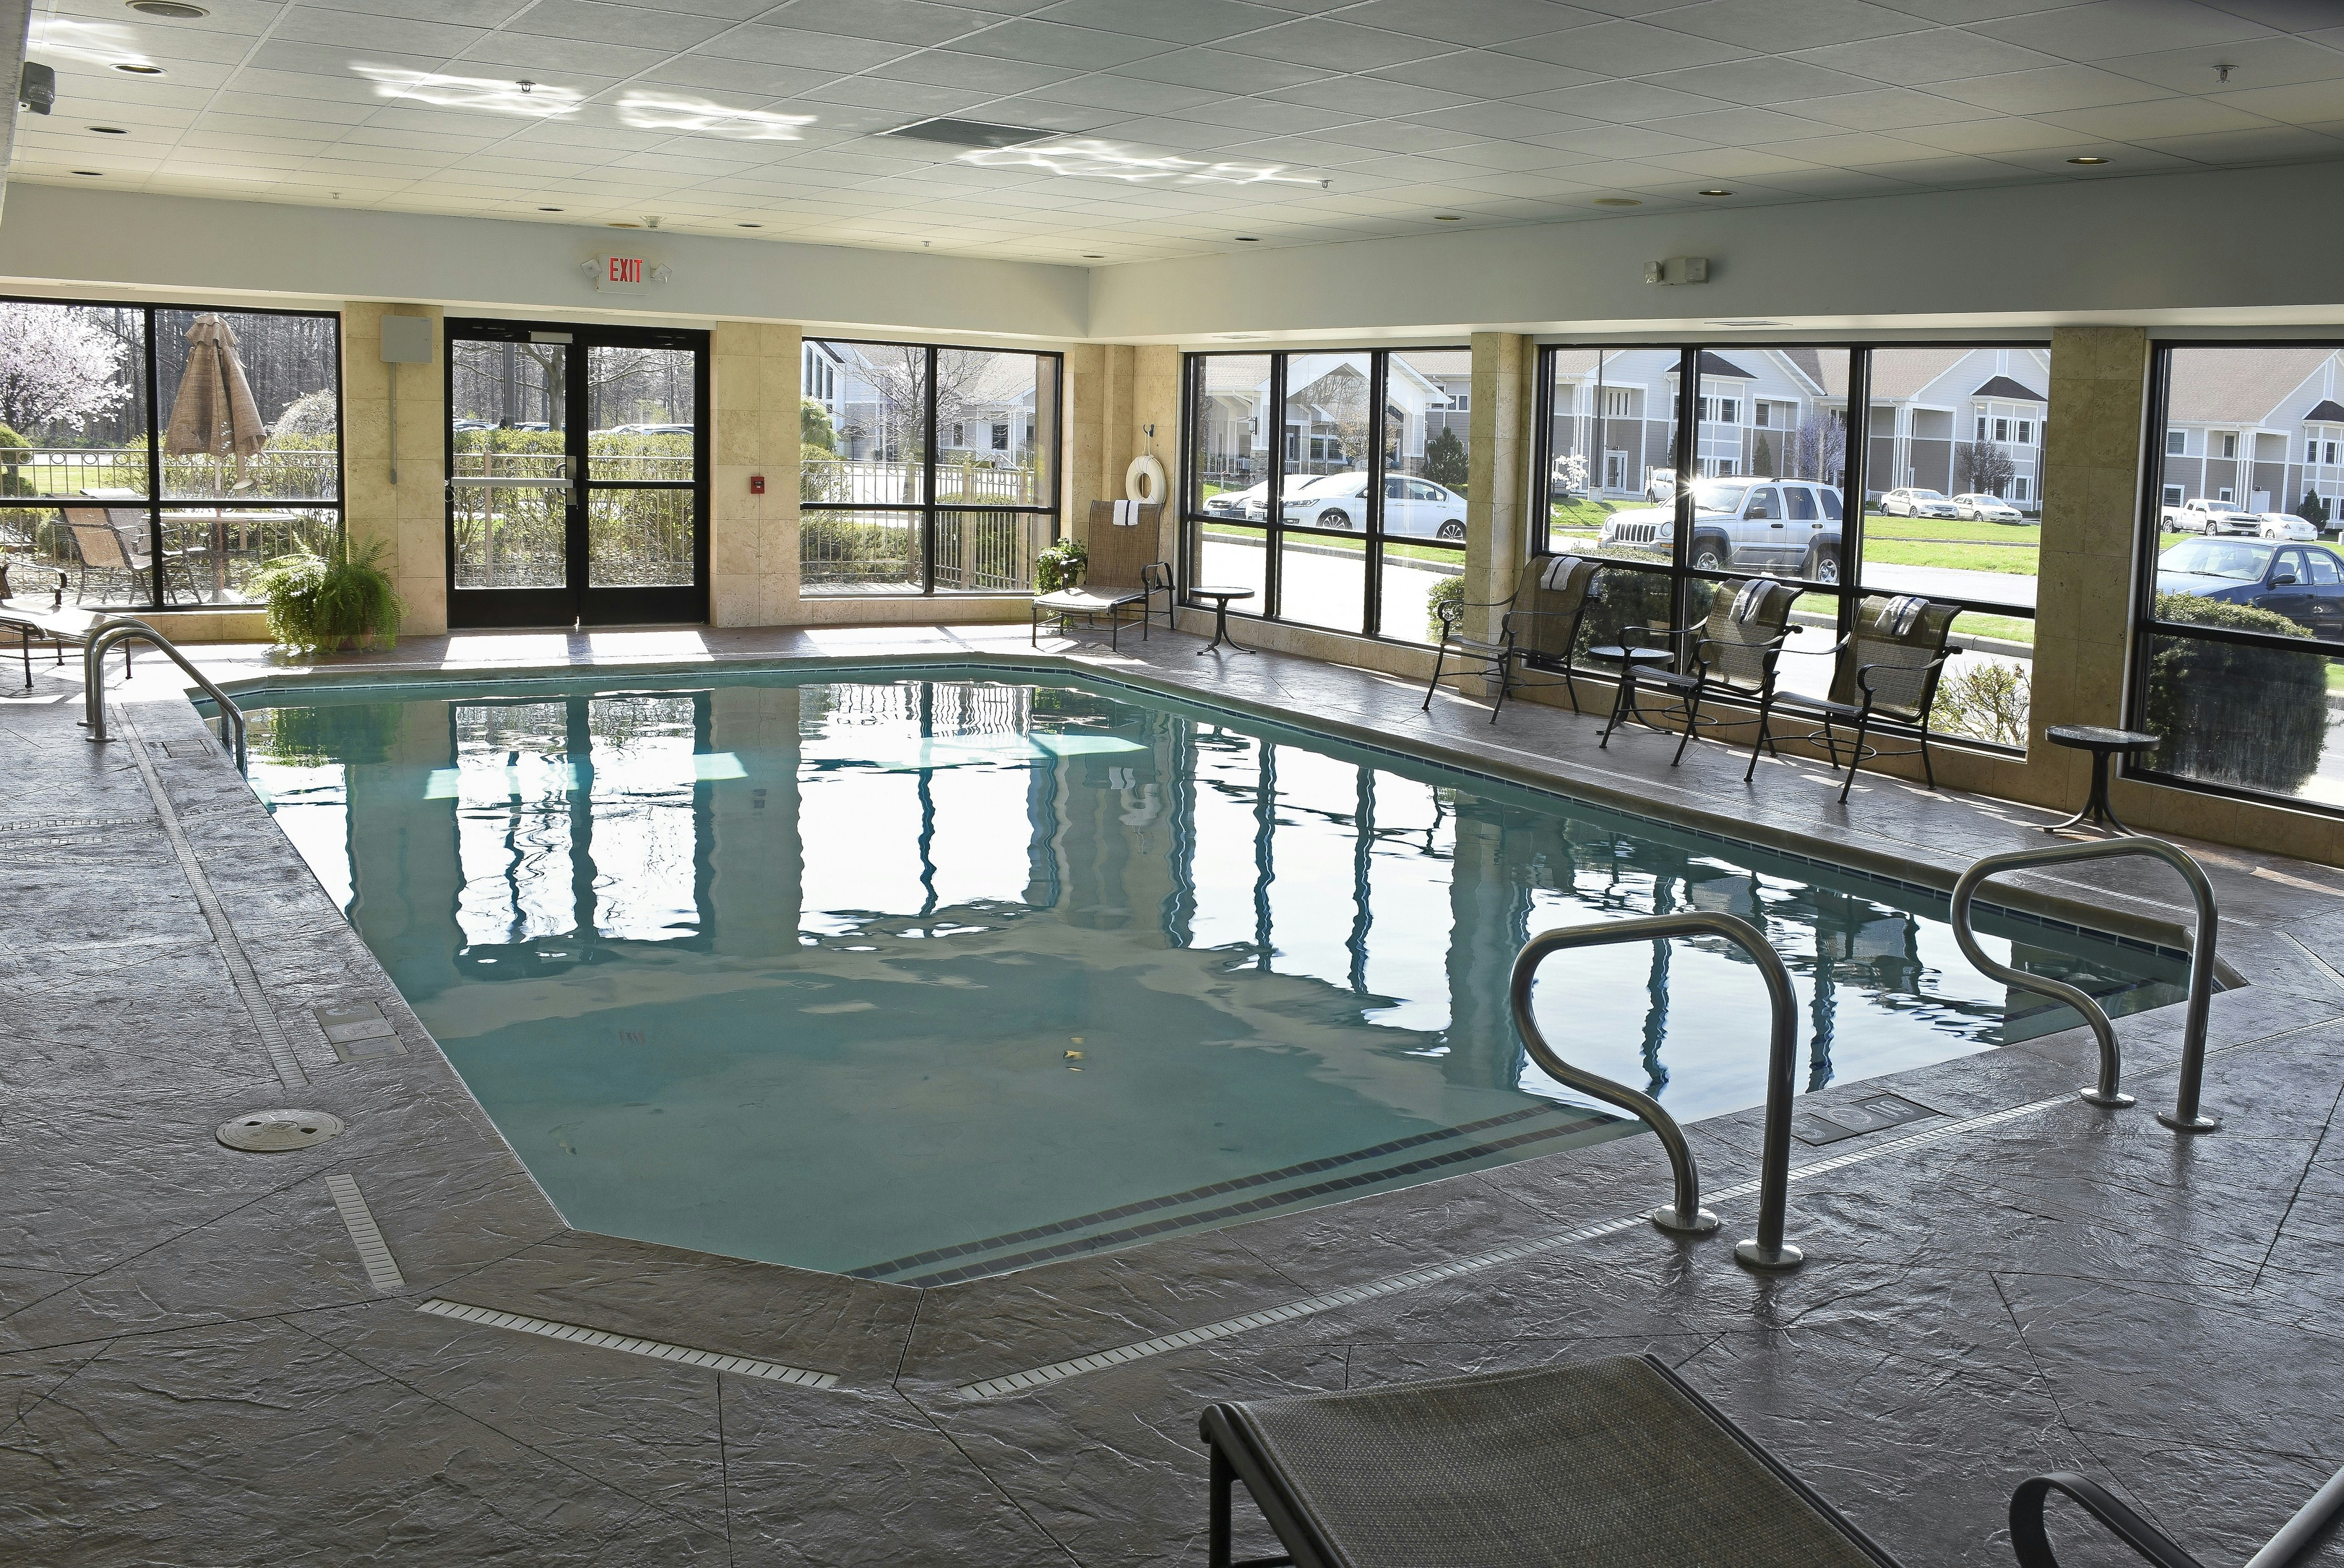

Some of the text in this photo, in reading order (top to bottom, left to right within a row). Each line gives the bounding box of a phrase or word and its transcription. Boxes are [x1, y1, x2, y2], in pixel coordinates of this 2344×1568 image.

[610, 257, 642, 283] EXIT
[1792, 1116, 1825, 1139] 3 FT
